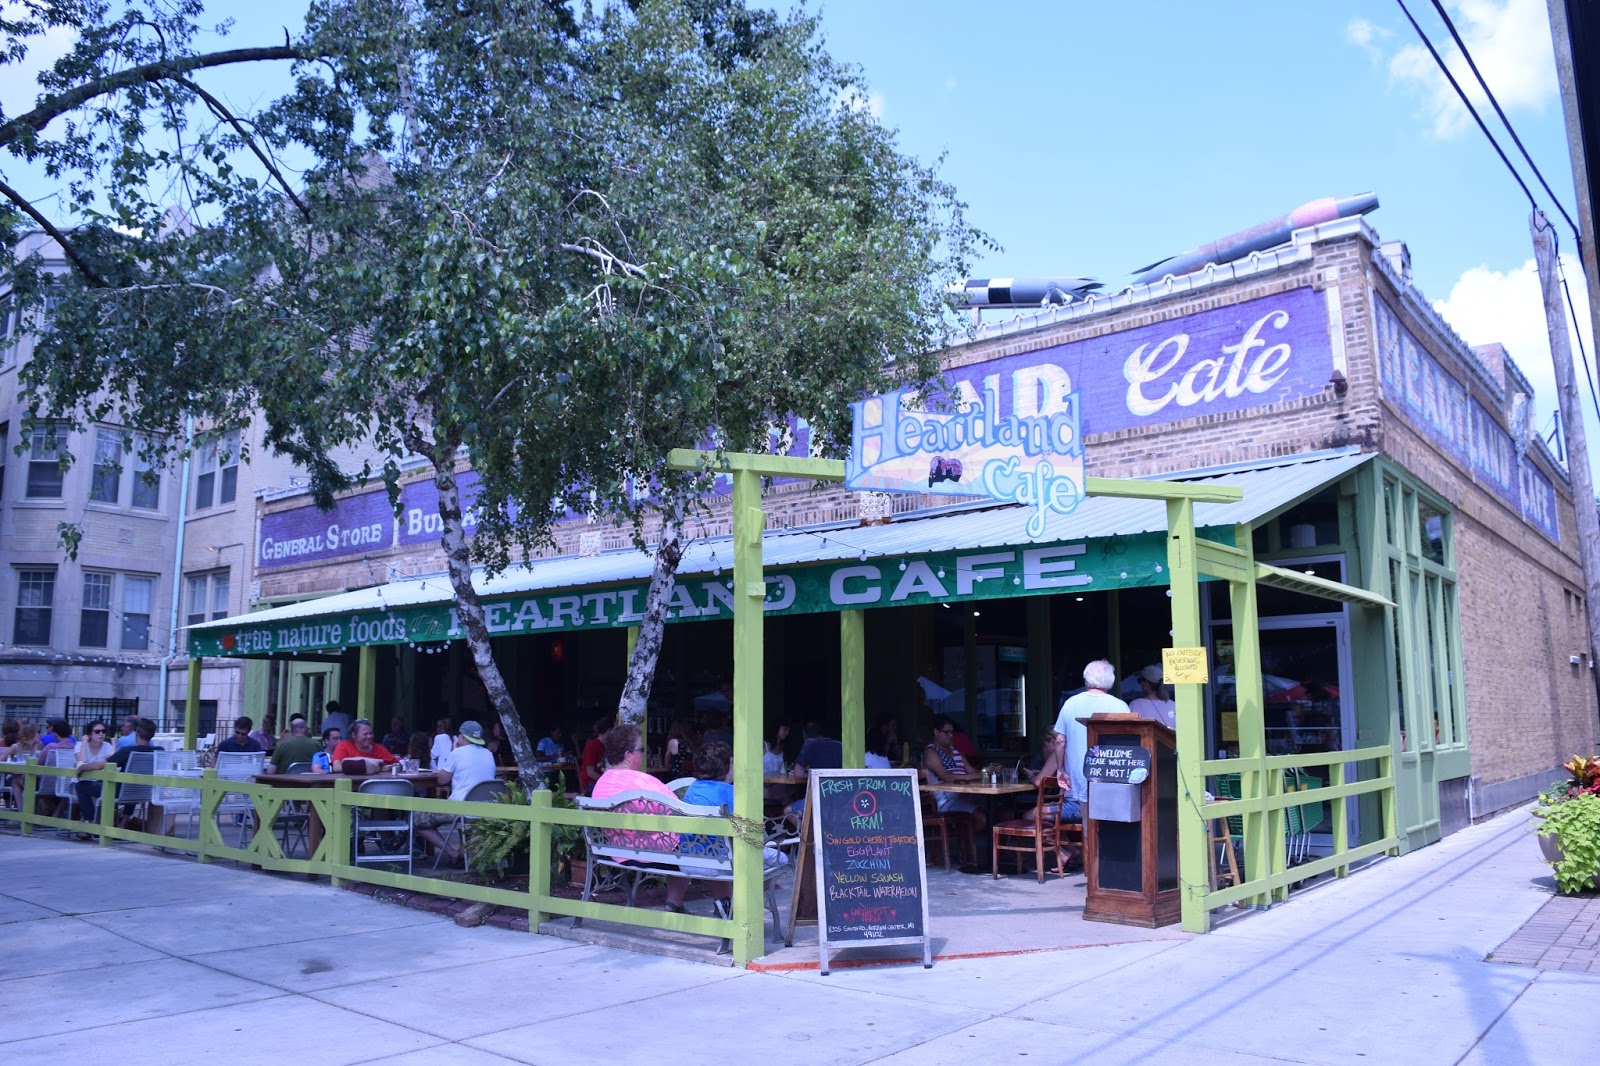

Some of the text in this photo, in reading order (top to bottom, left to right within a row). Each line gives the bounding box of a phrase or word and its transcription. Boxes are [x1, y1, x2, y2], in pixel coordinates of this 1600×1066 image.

[1123, 309, 1292, 418] Cafe
[847, 386, 1084, 480] Heartland
[982, 455, 1080, 538] Cafe
[261, 523, 382, 560] GENERAL STORE
[236, 628, 272, 651] true
[277, 622, 342, 649] nature
[348, 612, 406, 643] foods
[409, 614, 425, 629] at
[425, 617, 443, 637] the
[829, 544, 1088, 607] CAFE
[1100, 749, 1133, 758] WELCOME
[1086, 757, 1146, 767] PLEASE WAIT HERE
[1089, 767, 1102, 776] FOR
[820, 777, 911, 798] FRESH FROM OUR
[850, 810, 884, 830] FARM!
[862, 835, 887, 847] CHERRY
[846, 845, 893, 857] EGGPLANT
[845, 858, 891, 870] ZUCCHINI
[833, 871, 904, 884] YELLOW SQUASH
[873, 884, 917, 899] WATERMELON
